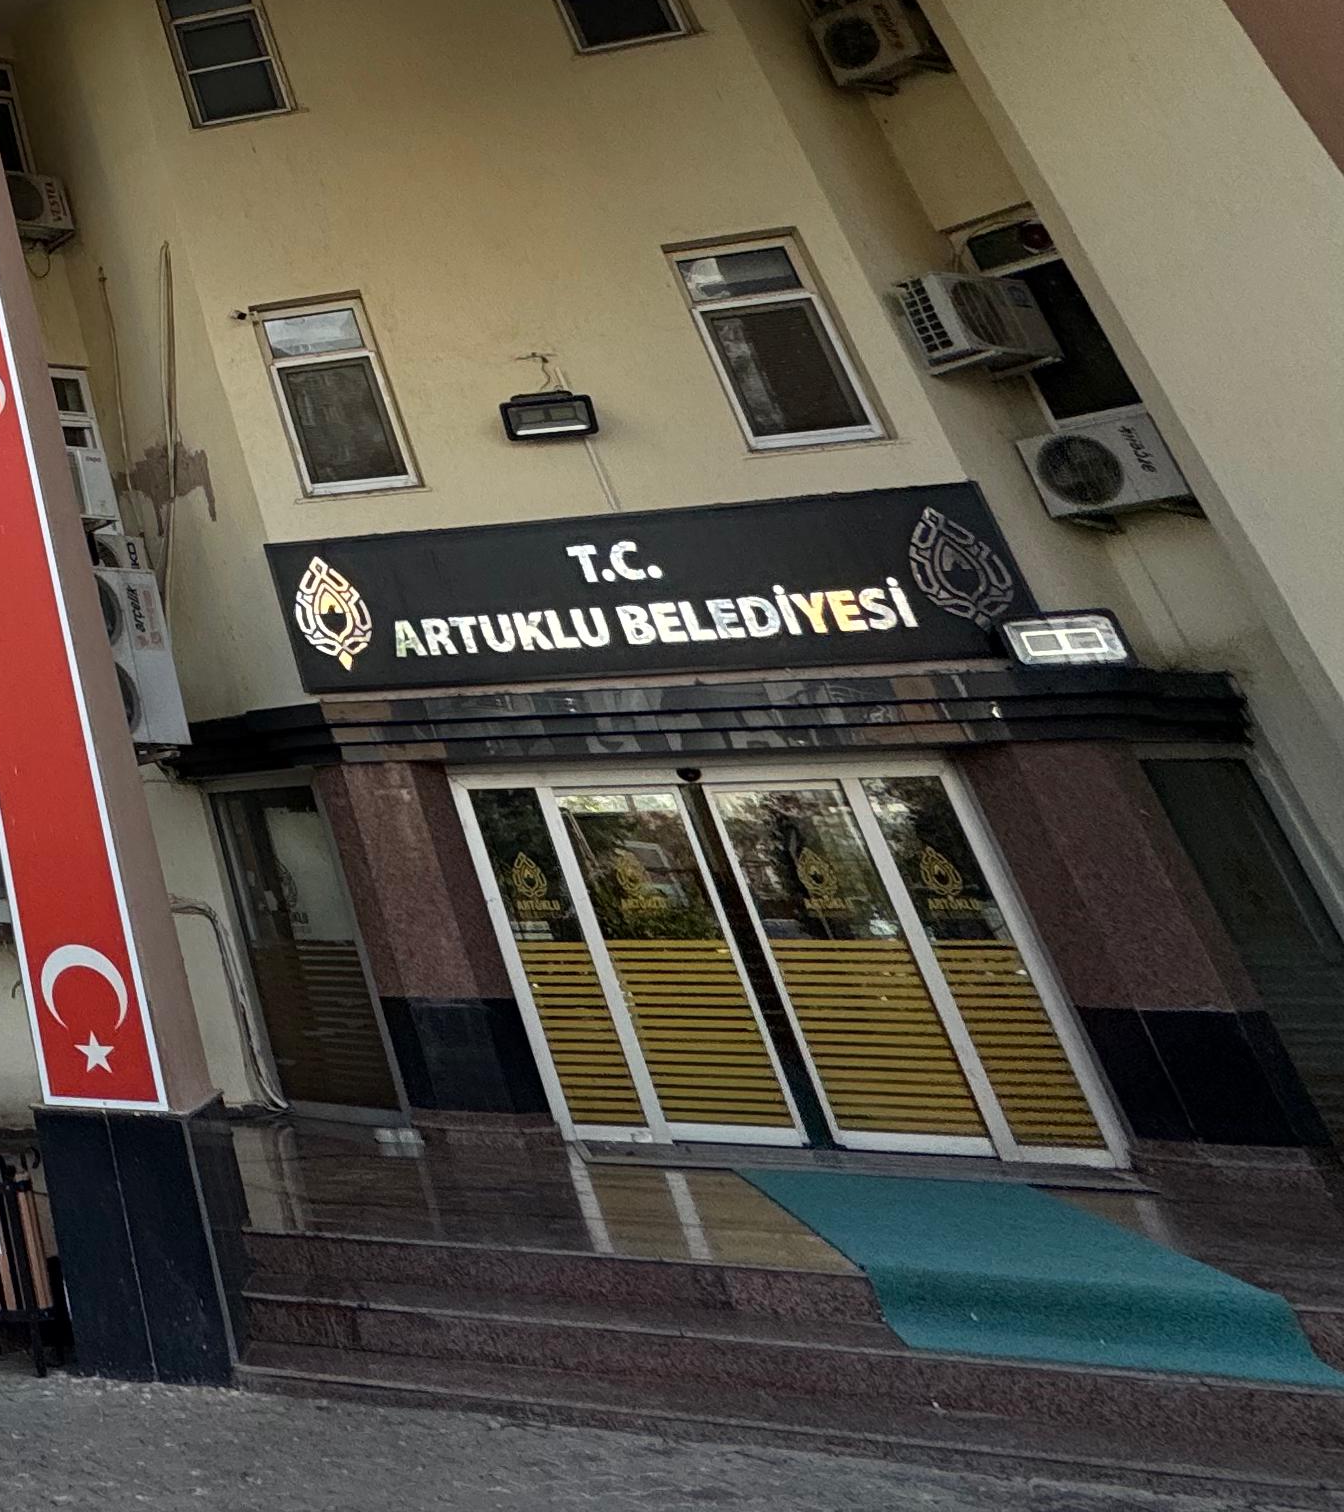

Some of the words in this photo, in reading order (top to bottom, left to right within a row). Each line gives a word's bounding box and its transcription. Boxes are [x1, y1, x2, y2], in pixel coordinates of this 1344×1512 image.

[565, 539, 664, 585] T.C.
[125, 585, 146, 633] arçelik
[393, 607, 610, 659] ARTUKLU
[622, 576, 920, 648] BELEDİYESİ
